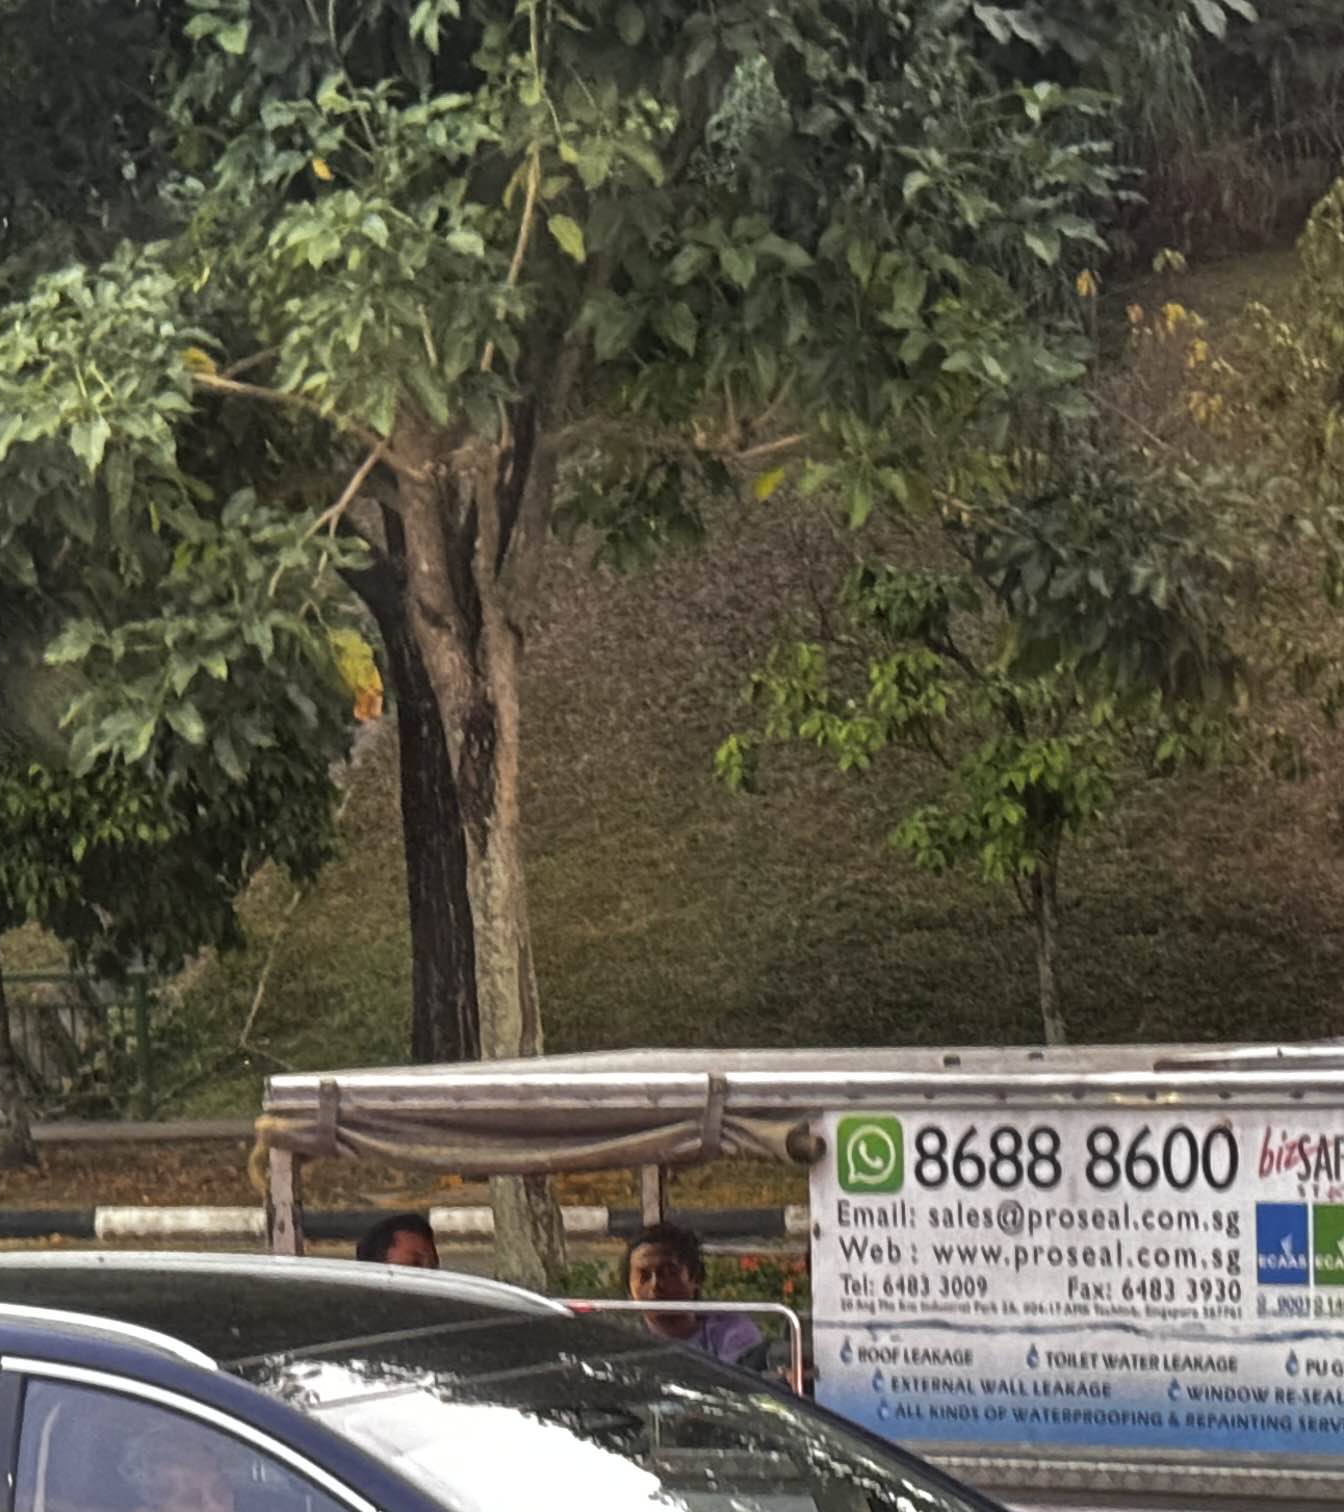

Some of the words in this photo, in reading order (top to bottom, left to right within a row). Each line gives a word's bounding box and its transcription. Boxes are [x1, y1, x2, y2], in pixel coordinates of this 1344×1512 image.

[914, 1125, 1062, 1189] 8688
[1085, 1124, 1239, 1191] 8600
[837, 1199, 916, 1228] Email:
[928, 1199, 1241, 1239] sales@proseal.com.sg
[838, 1235, 902, 1264] Web
[932, 1238, 1241, 1276] www.proseal.com.sg
[839, 1273, 875, 1296] Tel:
[882, 1274, 930, 1297] 6483
[938, 1274, 988, 1298] 3009
[1067, 1275, 1112, 1300] Fax:
[1121, 1276, 1175, 1302] 6483
[1186, 1277, 1242, 1304] 3930
[857, 1346, 900, 1364] ROOF
[903, 1347, 974, 1366] LEAKAGE
[1046, 1351, 1098, 1370] TOILET
[1101, 1352, 1160, 1371] WATER
[1163, 1354, 1239, 1374] LEAKAGE
[1305, 1358, 1329, 1377] PU
[890, 1375, 974, 1395] EXTERNAL
[979, 1377, 1028, 1396] WALL
[1032, 1379, 1112, 1398] LEAKAGE
[1186, 1385, 1269, 1404] WINDOW
[894, 1401, 923, 1419] ALL
[928, 1403, 979, 1421] KINDS
[983, 1405, 1007, 1422] OF
[1011, 1406, 1163, 1428] WATERPROOFING
[1185, 1411, 1293, 1433] REPAINTING
